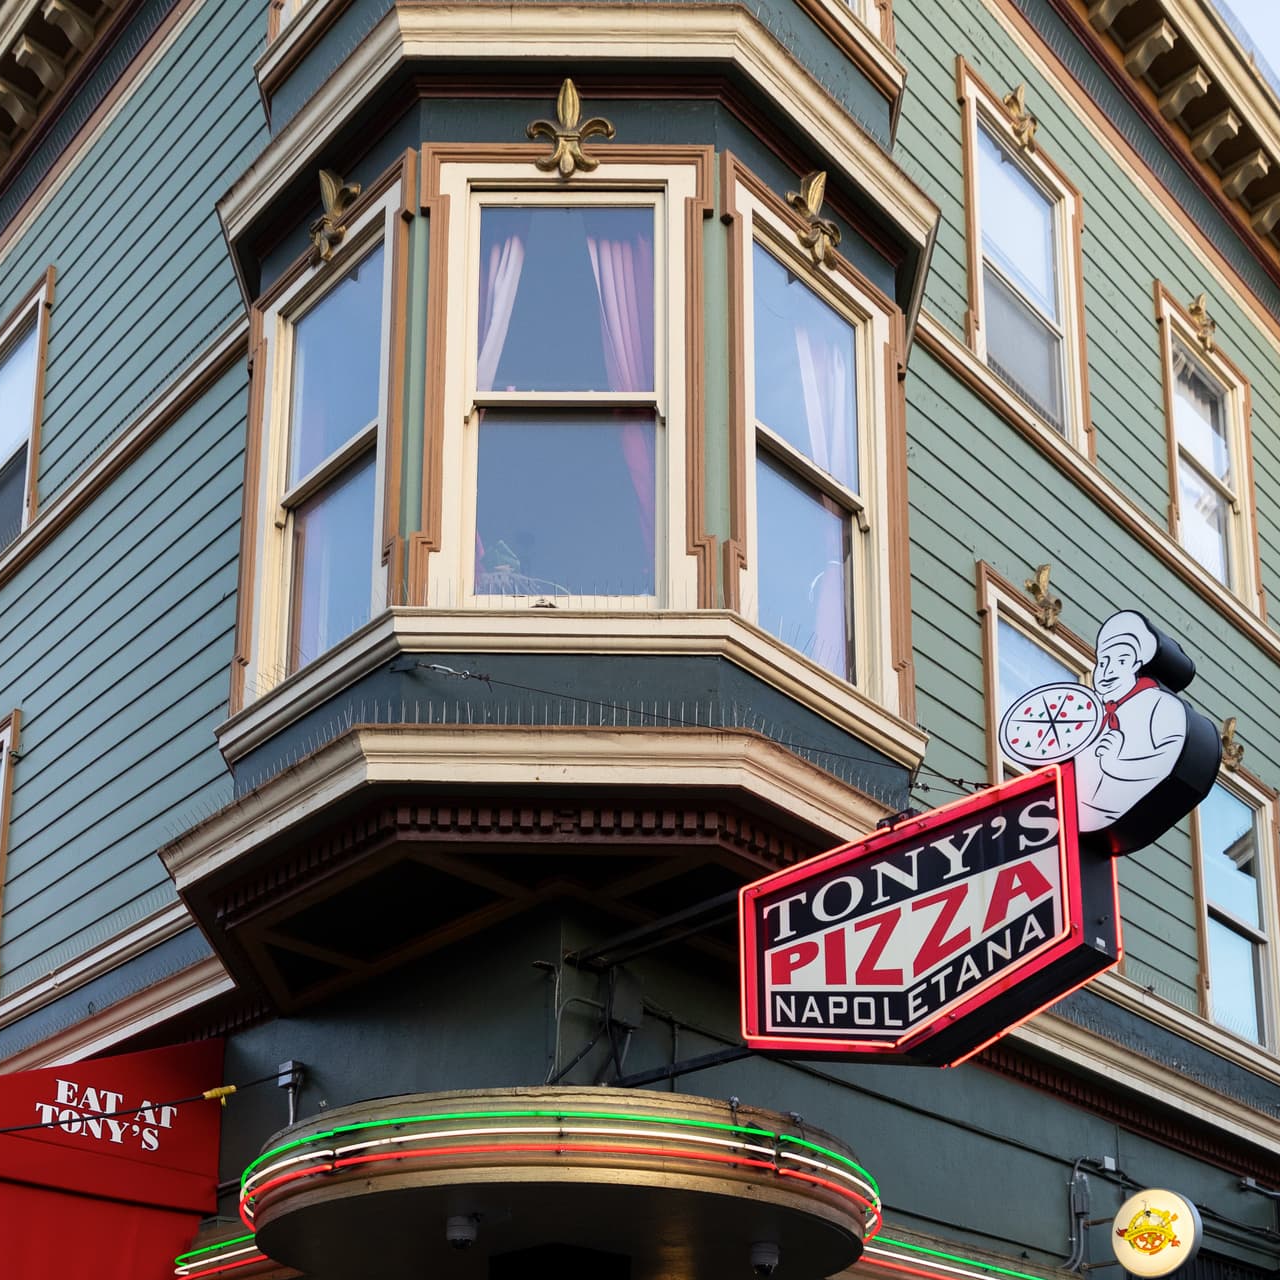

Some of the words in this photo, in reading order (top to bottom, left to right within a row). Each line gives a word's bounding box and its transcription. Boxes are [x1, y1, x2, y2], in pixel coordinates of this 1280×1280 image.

[762, 796, 1060, 942] TONY'S
[770, 860, 1055, 986] PIZZA
[775, 913, 1047, 1027] NAPOLETANA
[35, 1102, 159, 1151] TONY'S
[55, 1079, 124, 1114] EAT
[134, 1100, 177, 1129] AT
